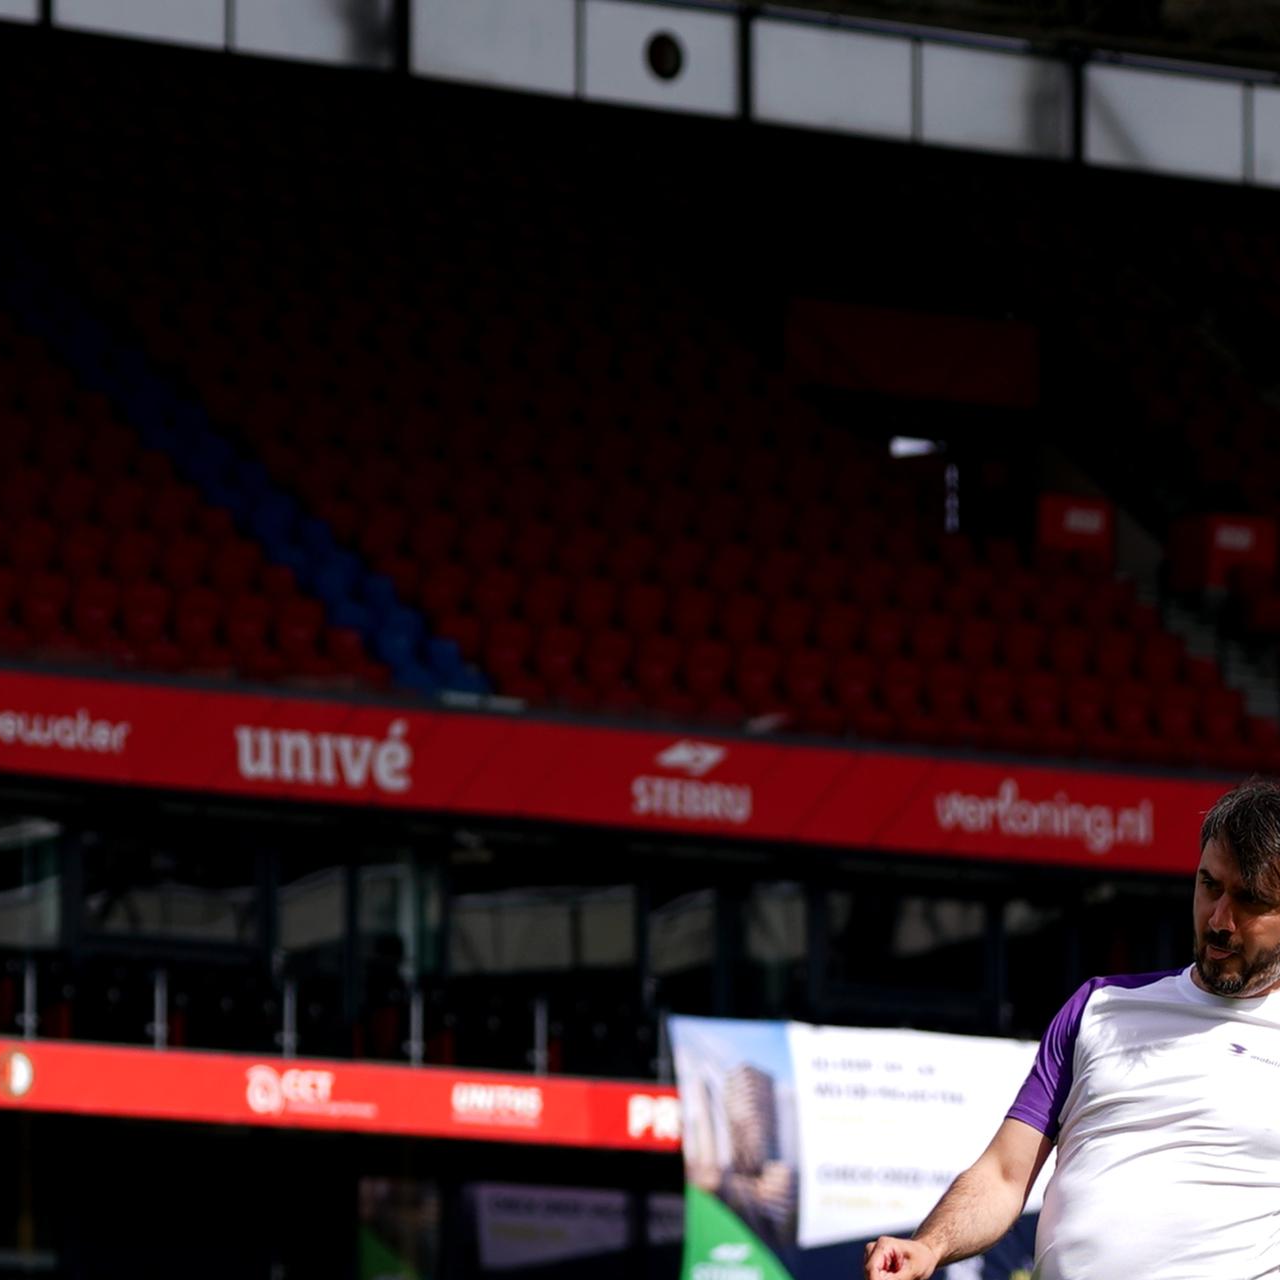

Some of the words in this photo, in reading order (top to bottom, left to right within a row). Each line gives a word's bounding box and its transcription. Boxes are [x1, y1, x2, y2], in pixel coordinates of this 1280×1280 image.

[234, 718, 413, 793] univé
[631, 775, 753, 822] STEBRU
[626, 1093, 683, 1141] PR
